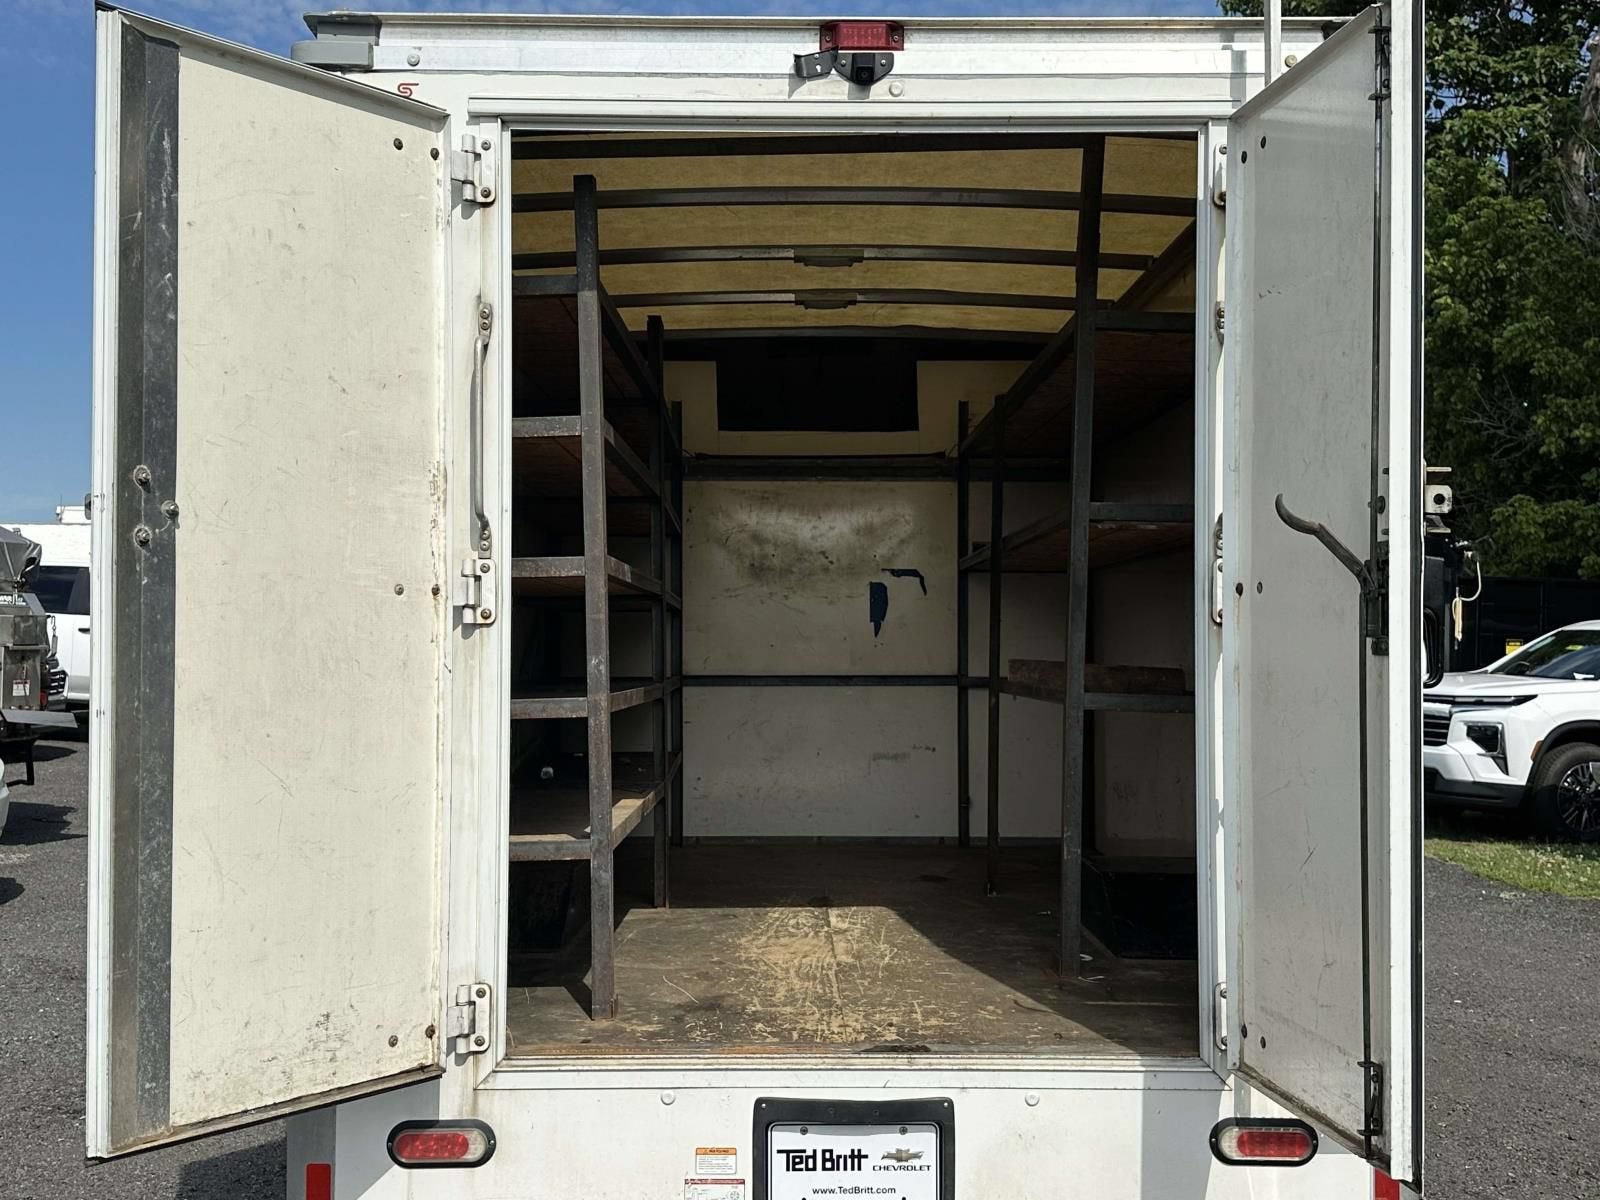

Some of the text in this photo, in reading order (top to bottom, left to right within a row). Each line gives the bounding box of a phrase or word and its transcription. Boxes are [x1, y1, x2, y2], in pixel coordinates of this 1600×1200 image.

[776, 1148, 869, 1172] Ted Britt
[872, 1164, 932, 1172] CHEVROLET
[812, 1185, 896, 1195] www.TedBritt.com
